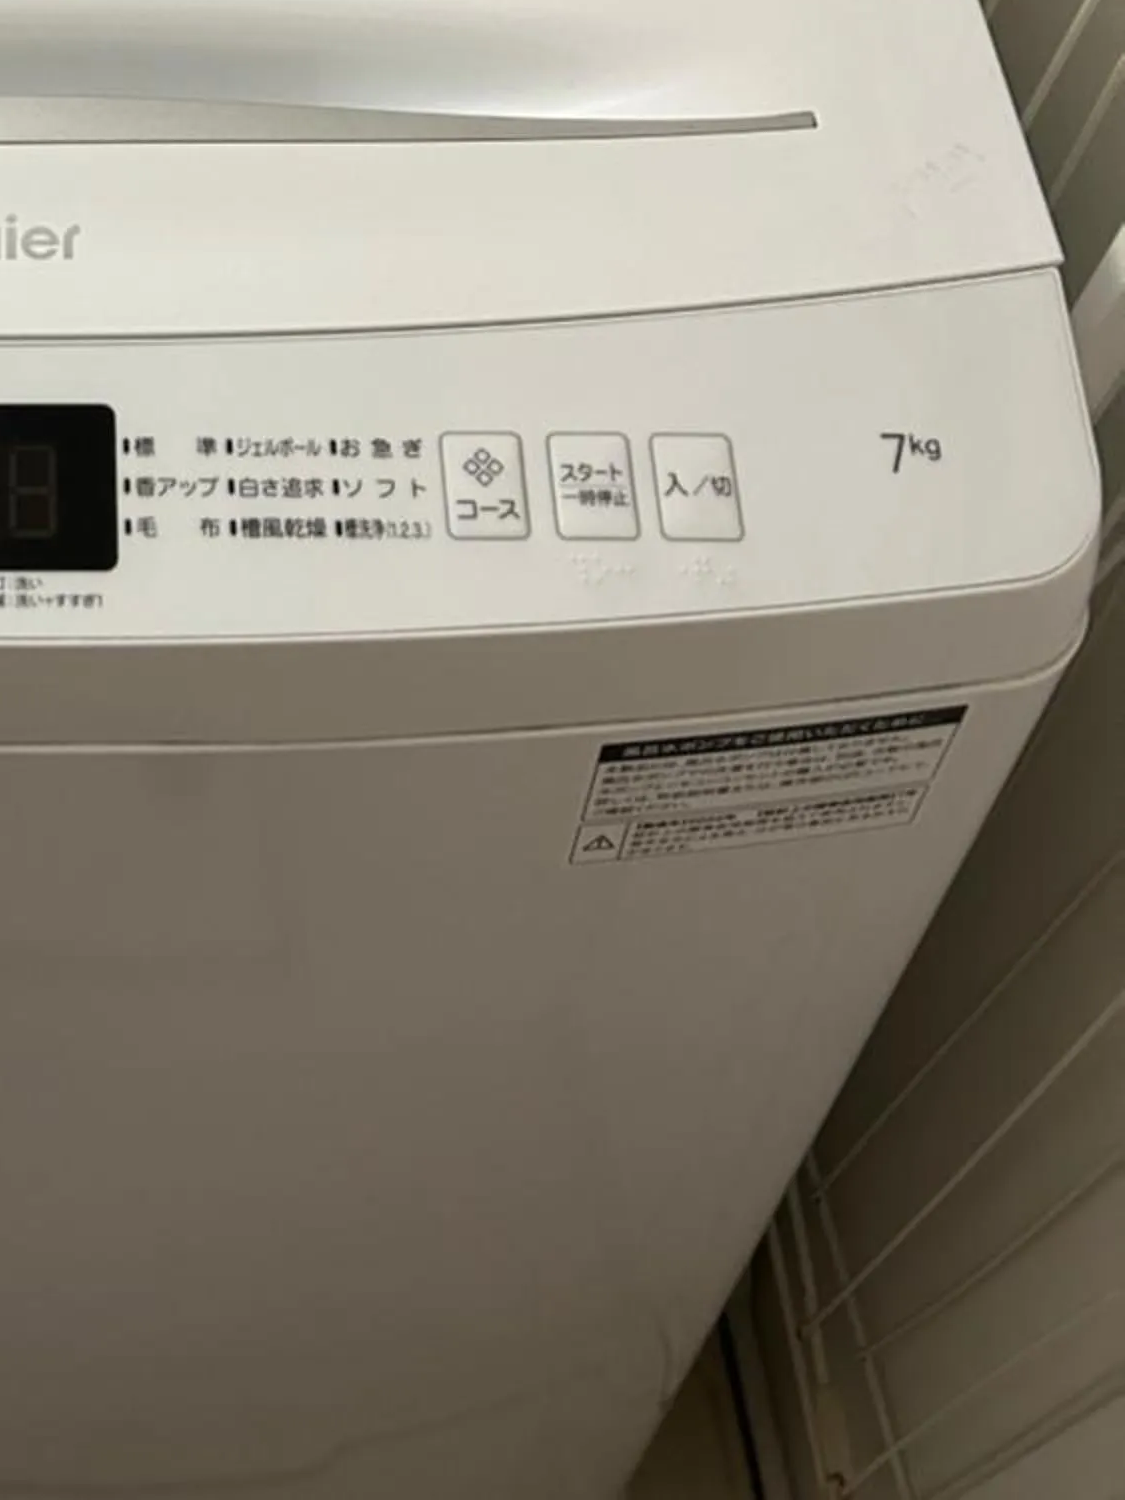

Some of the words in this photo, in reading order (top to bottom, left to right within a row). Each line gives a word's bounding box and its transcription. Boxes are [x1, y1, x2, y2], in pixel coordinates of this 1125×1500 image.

[340, 437, 423, 459] お急ぎ
[879, 432, 942, 474] 7kg
[561, 463, 623, 482] スタート
[136, 476, 219, 497] 香アップ
[239, 477, 324, 499] 白さ追求
[343, 478, 427, 498] ソフト
[456, 498, 520, 520] コース
[136, 516, 221, 538] 毛布
